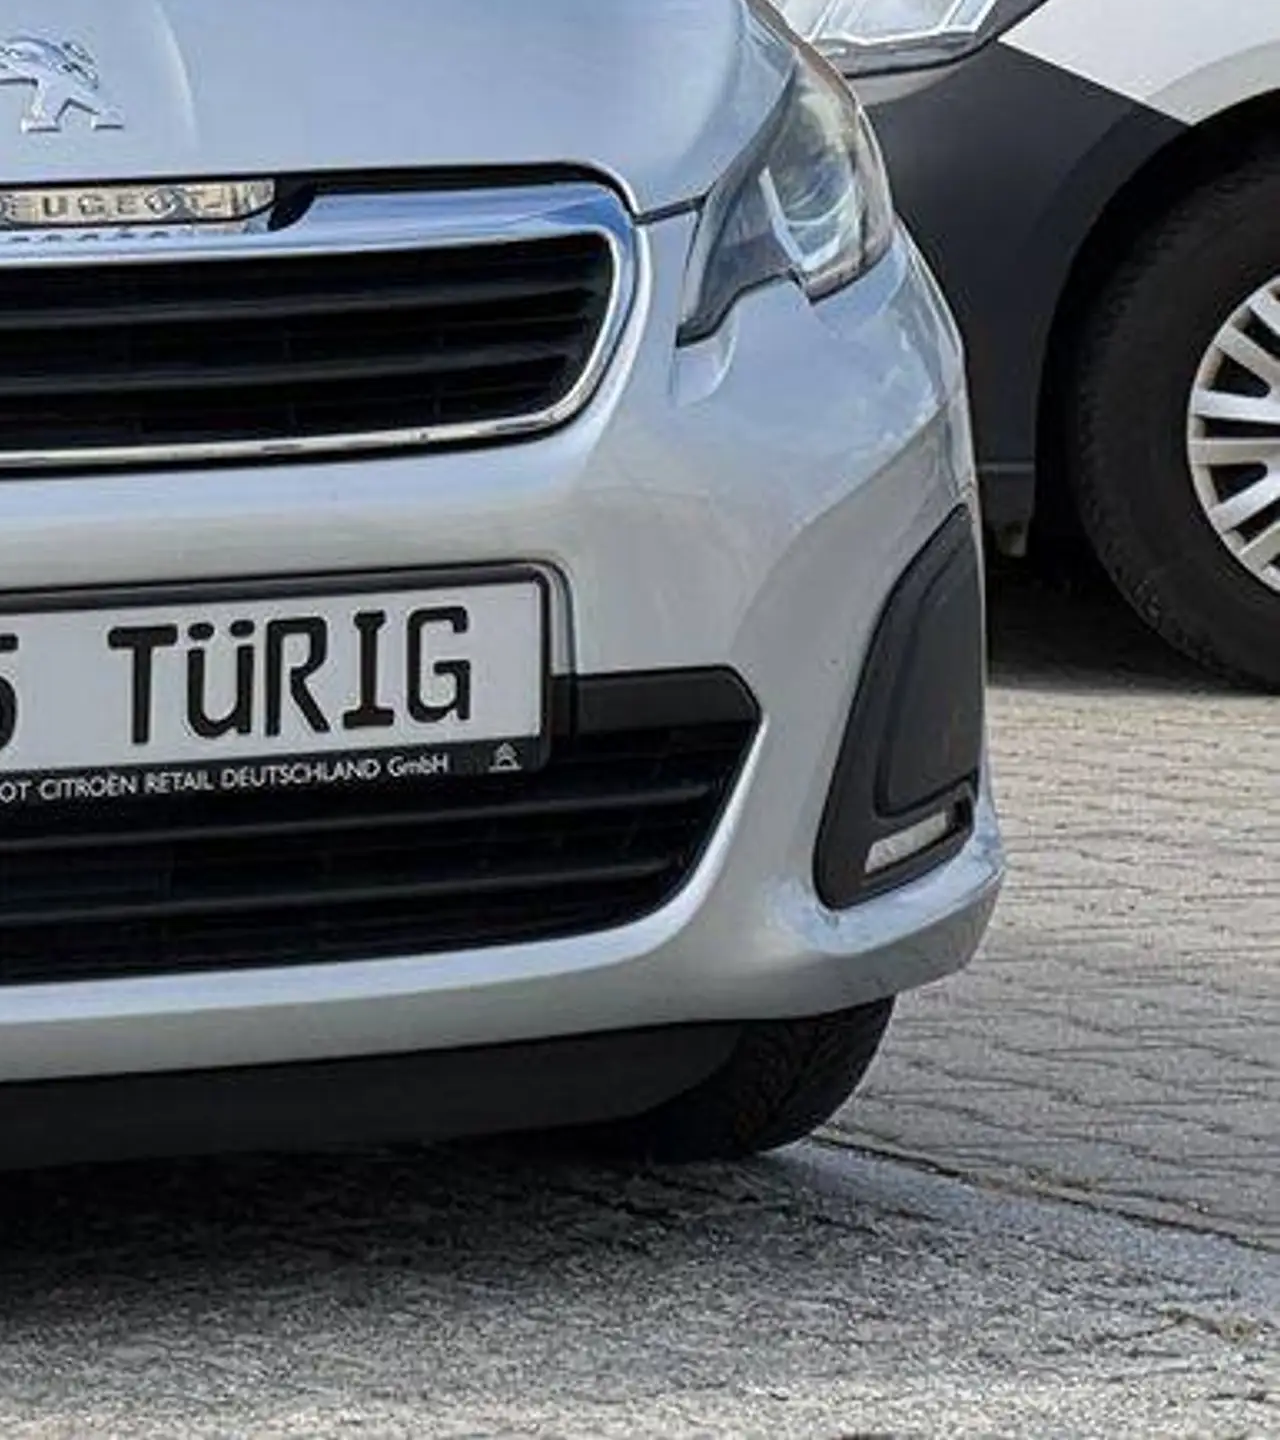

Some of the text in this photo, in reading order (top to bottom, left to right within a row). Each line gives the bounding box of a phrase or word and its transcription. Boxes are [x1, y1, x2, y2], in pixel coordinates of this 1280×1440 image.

[144, 766, 216, 794] RETAIL
[220, 758, 382, 789] DEUTSCHLAND
[387, 754, 449, 778] GmbH
